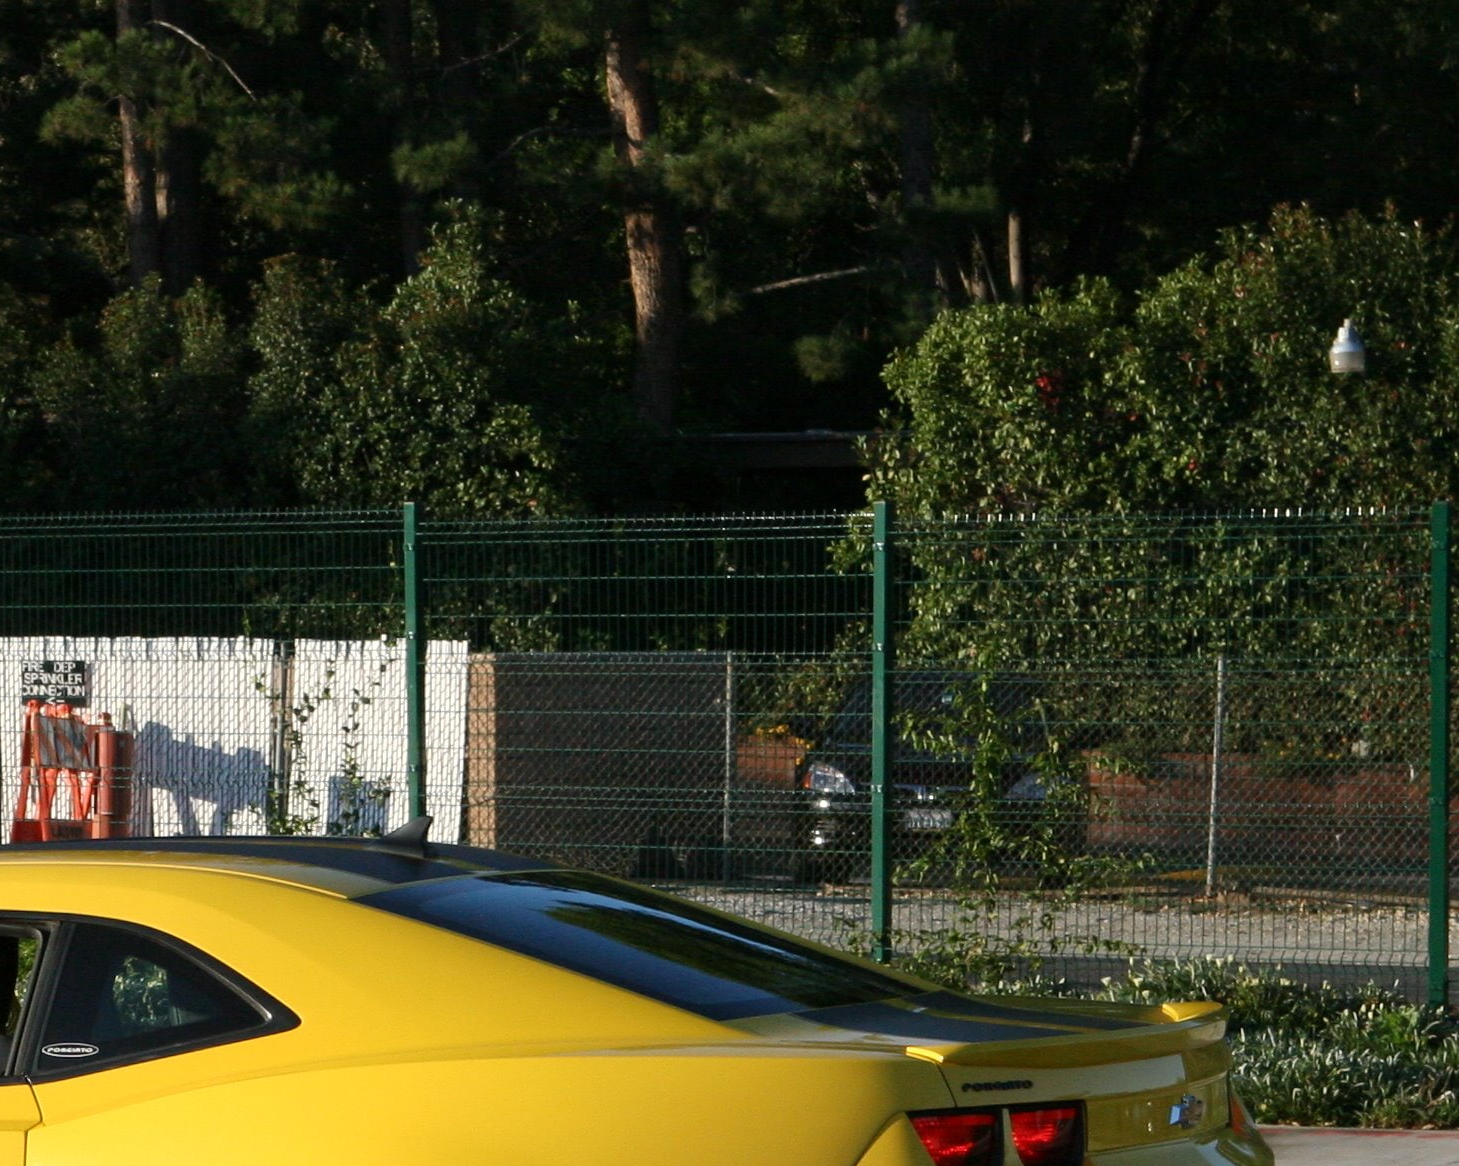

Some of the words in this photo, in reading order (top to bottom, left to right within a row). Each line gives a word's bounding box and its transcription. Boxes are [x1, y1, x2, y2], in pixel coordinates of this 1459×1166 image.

[22, 661, 44, 673] FIRE
[23, 672, 83, 685] SPRINKLER
[22, 684, 85, 697] CONNECTION
